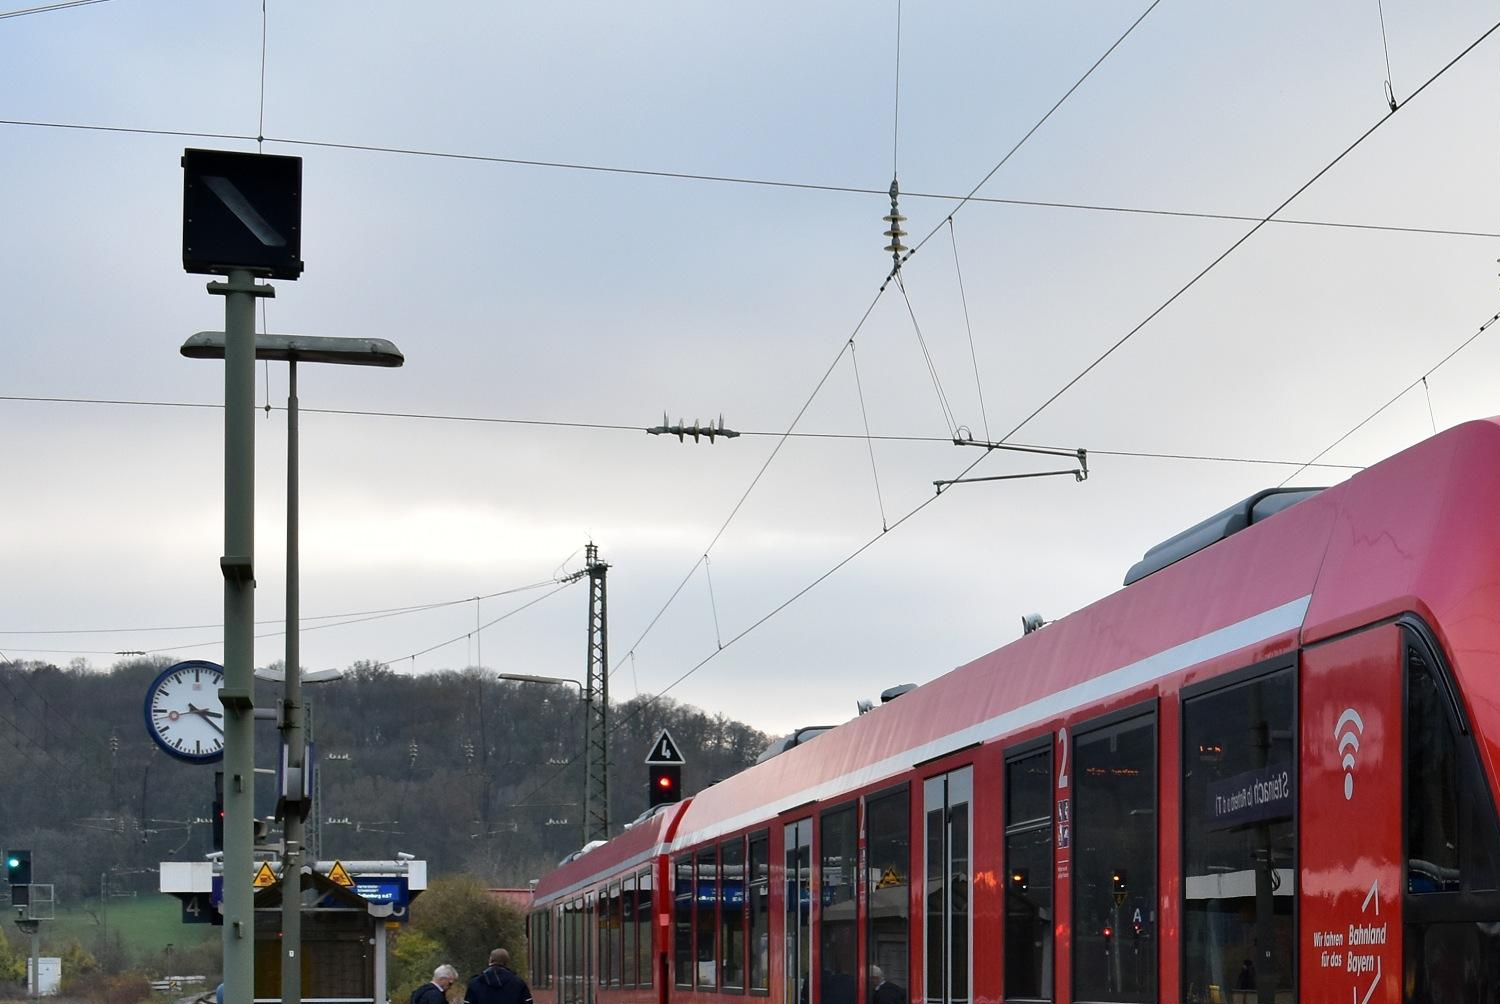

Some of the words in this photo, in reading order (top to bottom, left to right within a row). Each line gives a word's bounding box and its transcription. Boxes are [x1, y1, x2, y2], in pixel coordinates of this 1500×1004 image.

[661, 740, 671, 758] 4
[1058, 727, 1068, 788] 2
[860, 795, 865, 839] 2
[186, 896, 200, 917] 4
[1314, 931, 1323, 948] Wir
[1324, 931, 1343, 947] fahren
[1349, 922, 1387, 946] Bahnland
[1321, 951, 1329, 968] für
[1330, 952, 1342, 968] das
[1347, 951, 1374, 977] Bayern
